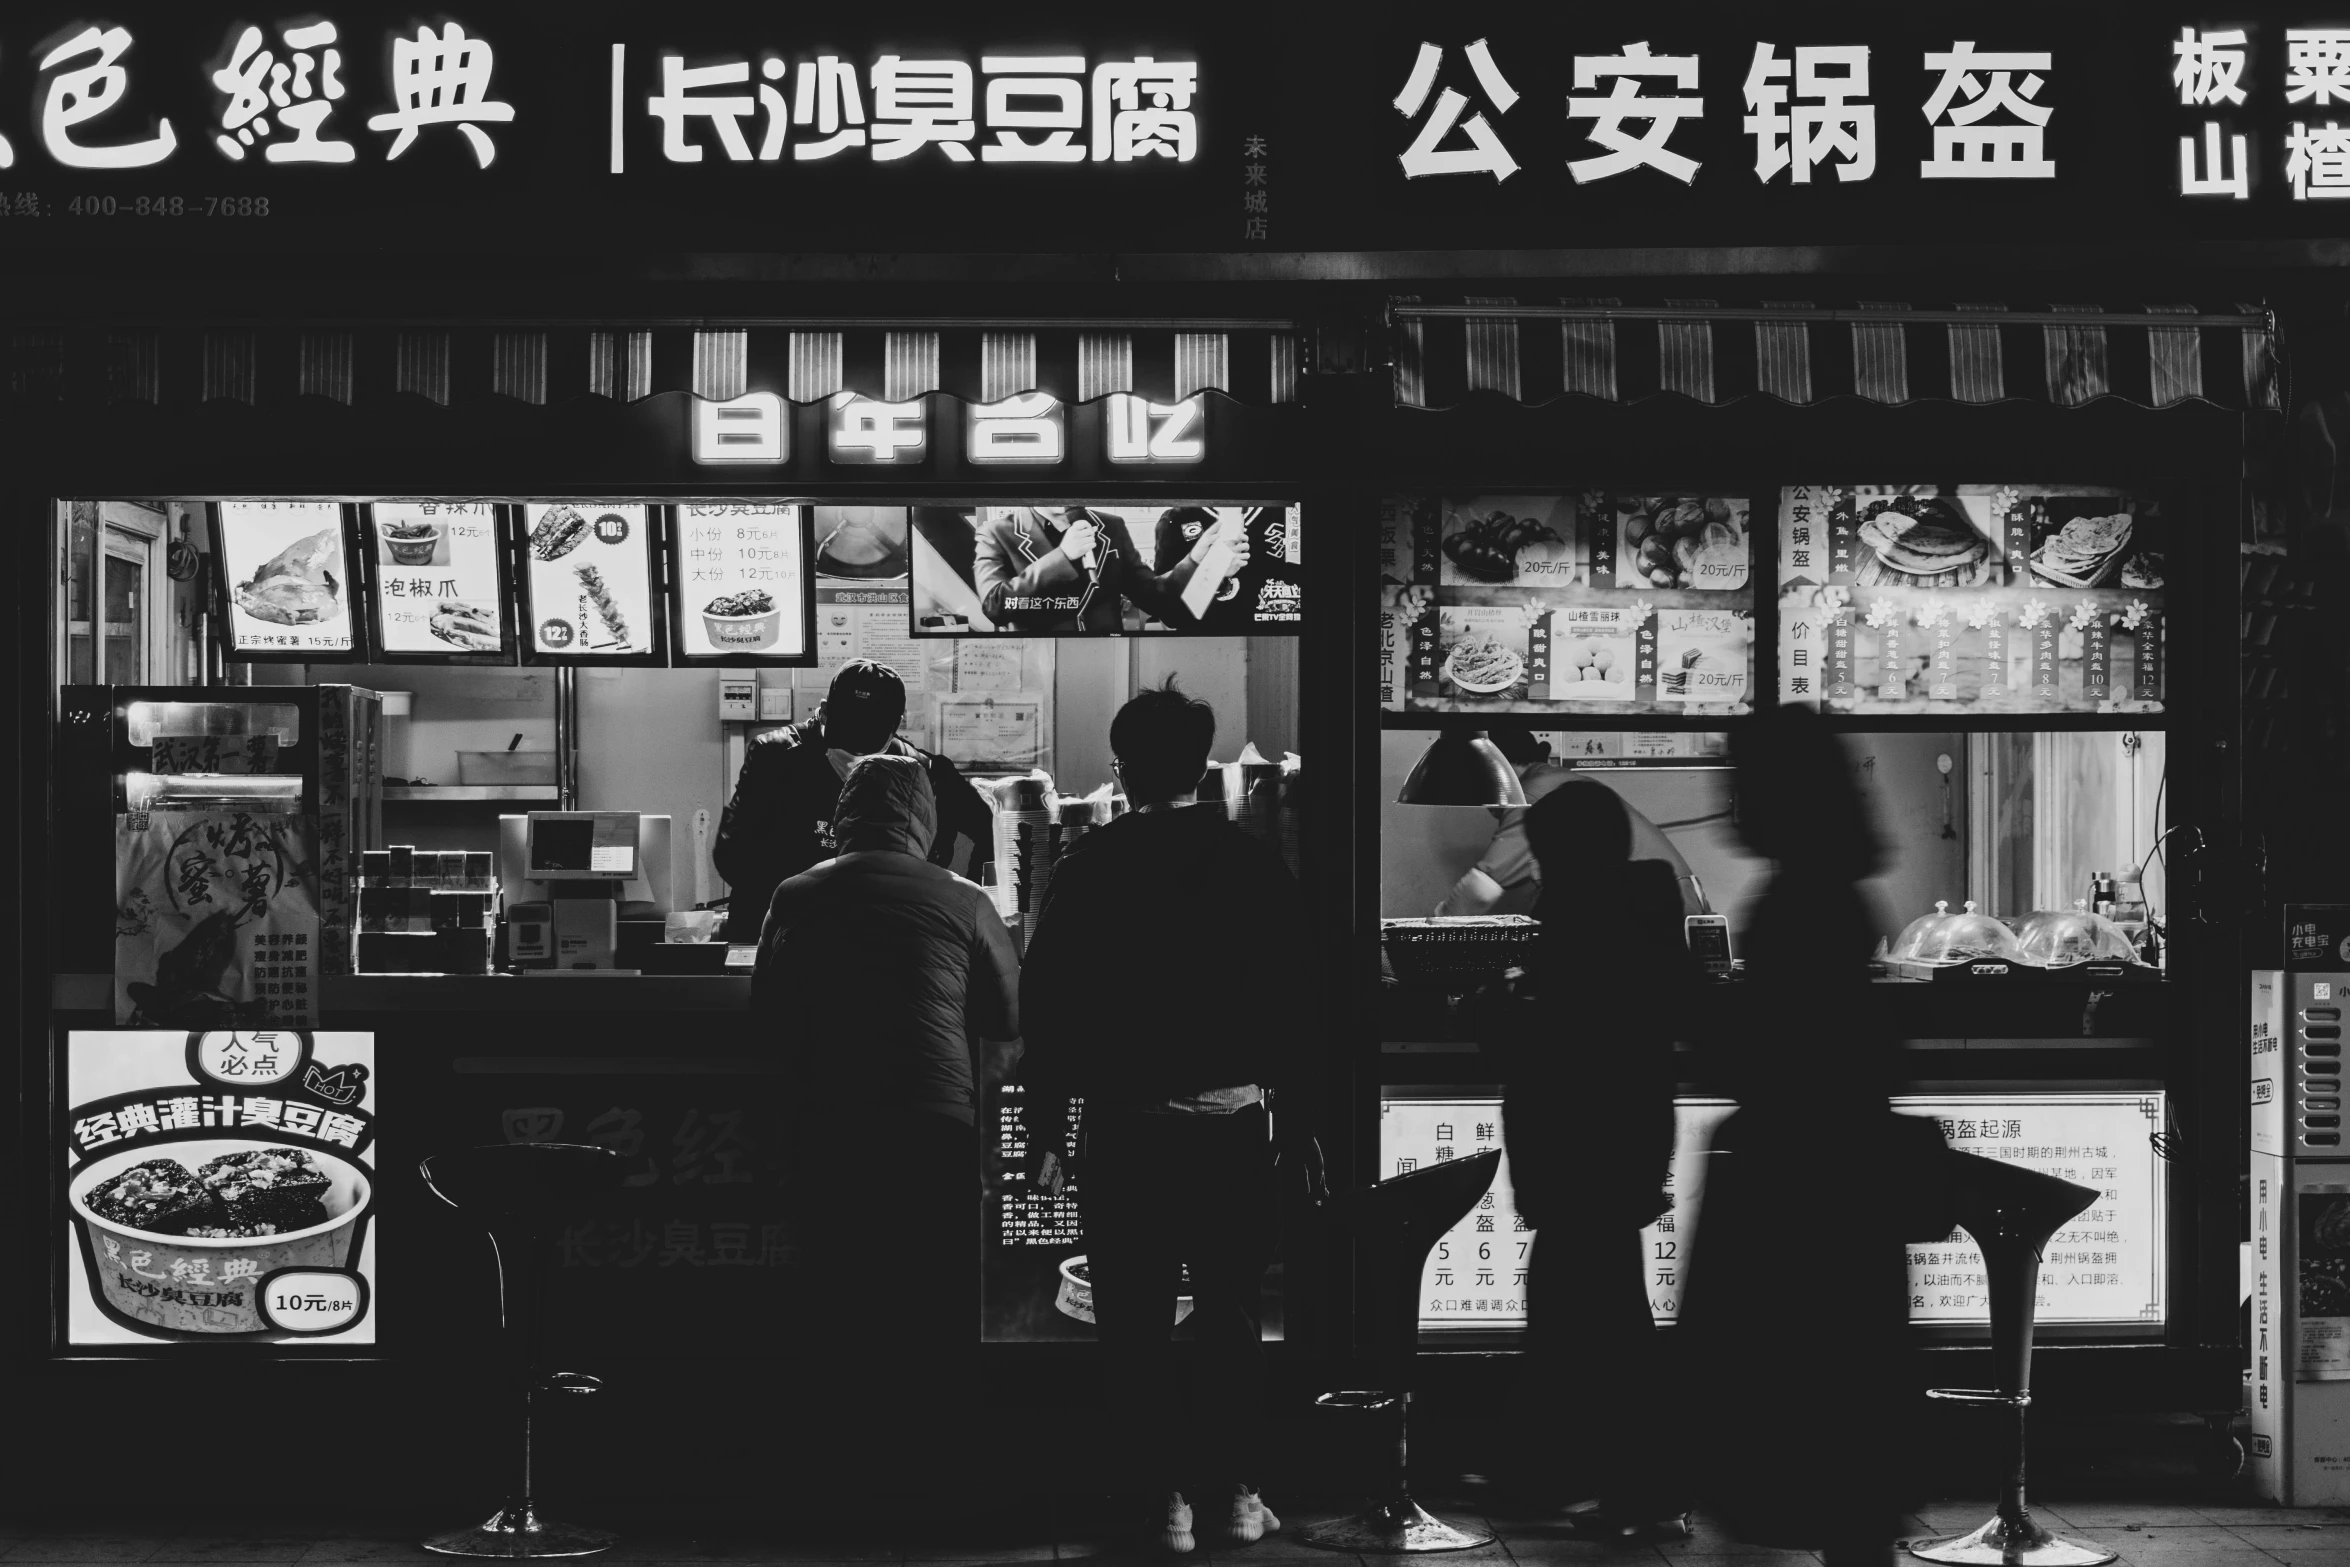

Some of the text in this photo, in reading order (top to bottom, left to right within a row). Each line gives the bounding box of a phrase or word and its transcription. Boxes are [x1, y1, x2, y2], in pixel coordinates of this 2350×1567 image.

[0, 21, 516, 169] 色經典
[648, 55, 1199, 162] 长沙臭豆腐
[1393, 40, 2056, 185] 公安锅盔
[2180, 121, 2350, 200] 山楂
[1244, 133, 1268, 240] 未来城店
[67, 195, 270, 216] 400-848-7688
[690, 527, 722, 541] 小份
[1791, 485, 1811, 568] 公安锅盔
[690, 547, 723, 562] 中份
[691, 567, 724, 582] 大份
[1524, 561, 1571, 575] 20元/斤
[1699, 563, 1747, 577] 20元/斤
[384, 577, 460, 598] 泡椒爪
[835, 592, 909, 603] 武汉市洪山区食
[1004, 597, 1080, 609] 对看这个东西
[578, 594, 589, 647] 老长沙大香肠
[1568, 610, 1621, 622] 山楂雪丽球
[1671, 612, 1732, 634] 山楂汉堡
[308, 636, 351, 647] 15元/斤
[1419, 626, 1433, 680] 色泽自然
[1532, 628, 1547, 682] 酸甜爽口
[1639, 629, 1654, 683] 色泽自然
[1791, 621, 1810, 694] 价目表
[1698, 673, 1744, 687] 20元/斤
[153, 735, 275, 773] 武汉第一薯
[254, 933, 308, 946] 美容养颜
[2291, 923, 2316, 936] 小电
[2291, 934, 2329, 949] 充电宝
[266, 998, 308, 1011] 护心脏
[221, 1032, 280, 1053] 人气
[220, 1054, 280, 1076] 必点
[313, 1080, 345, 1097] HOT
[73, 1095, 367, 1151] 经典灌汁臭豆腐
[1435, 1122, 1454, 1164] 白糖
[102, 1234, 264, 1286] 黑色經典
[2050, 1253, 2118, 1265] 荆州锅盔拥
[118, 1273, 244, 1307] 长沙臭豆腐
[275, 1293, 353, 1312] 10元/8片
